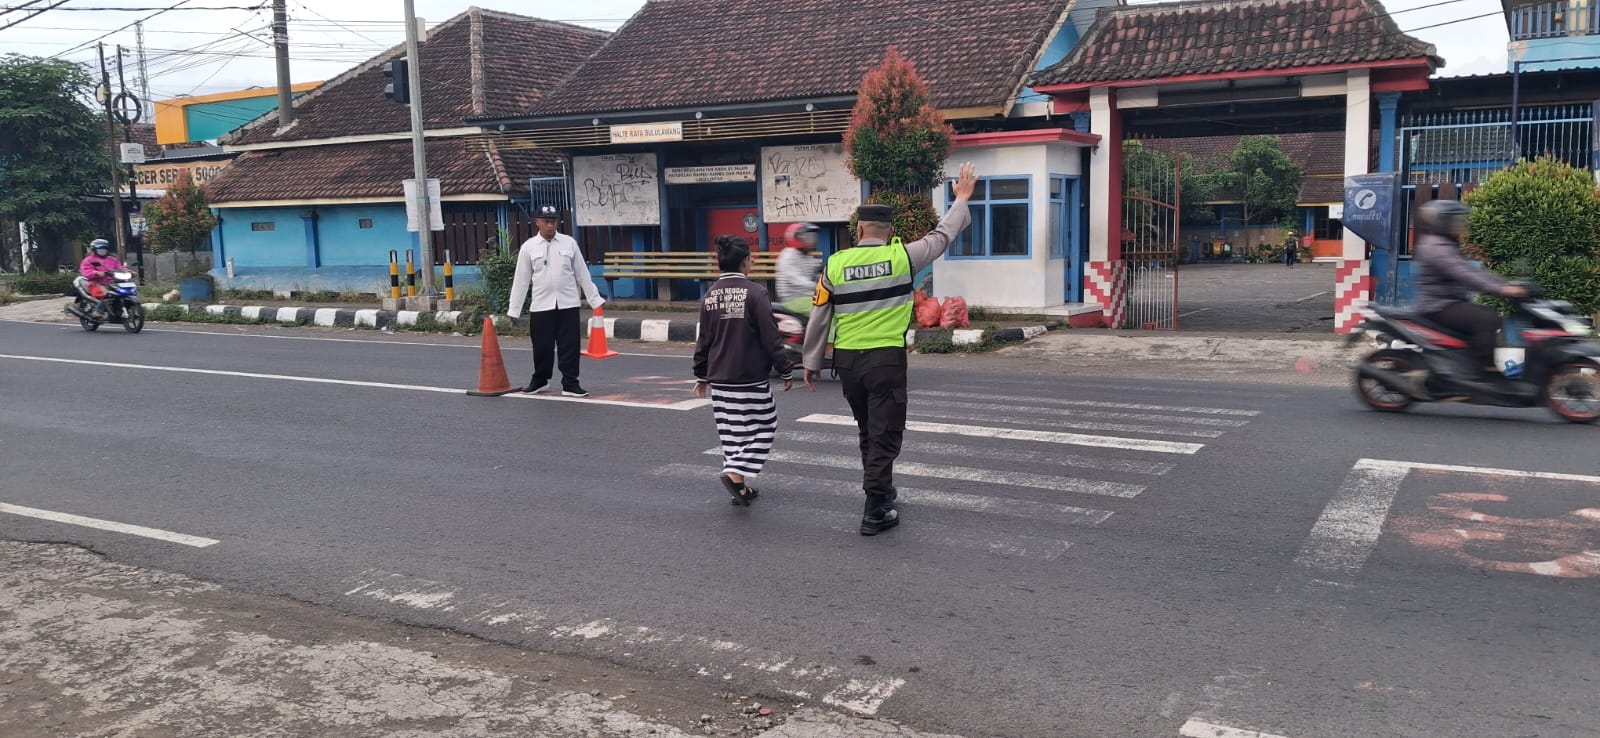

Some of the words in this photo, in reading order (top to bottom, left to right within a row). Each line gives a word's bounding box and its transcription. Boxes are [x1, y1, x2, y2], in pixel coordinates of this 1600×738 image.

[630, 130, 643, 138] RAYA
[644, 128, 681, 137] BULULAWANG
[846, 262, 890, 280] POLISI
[705, 296, 718, 305] INDIE
